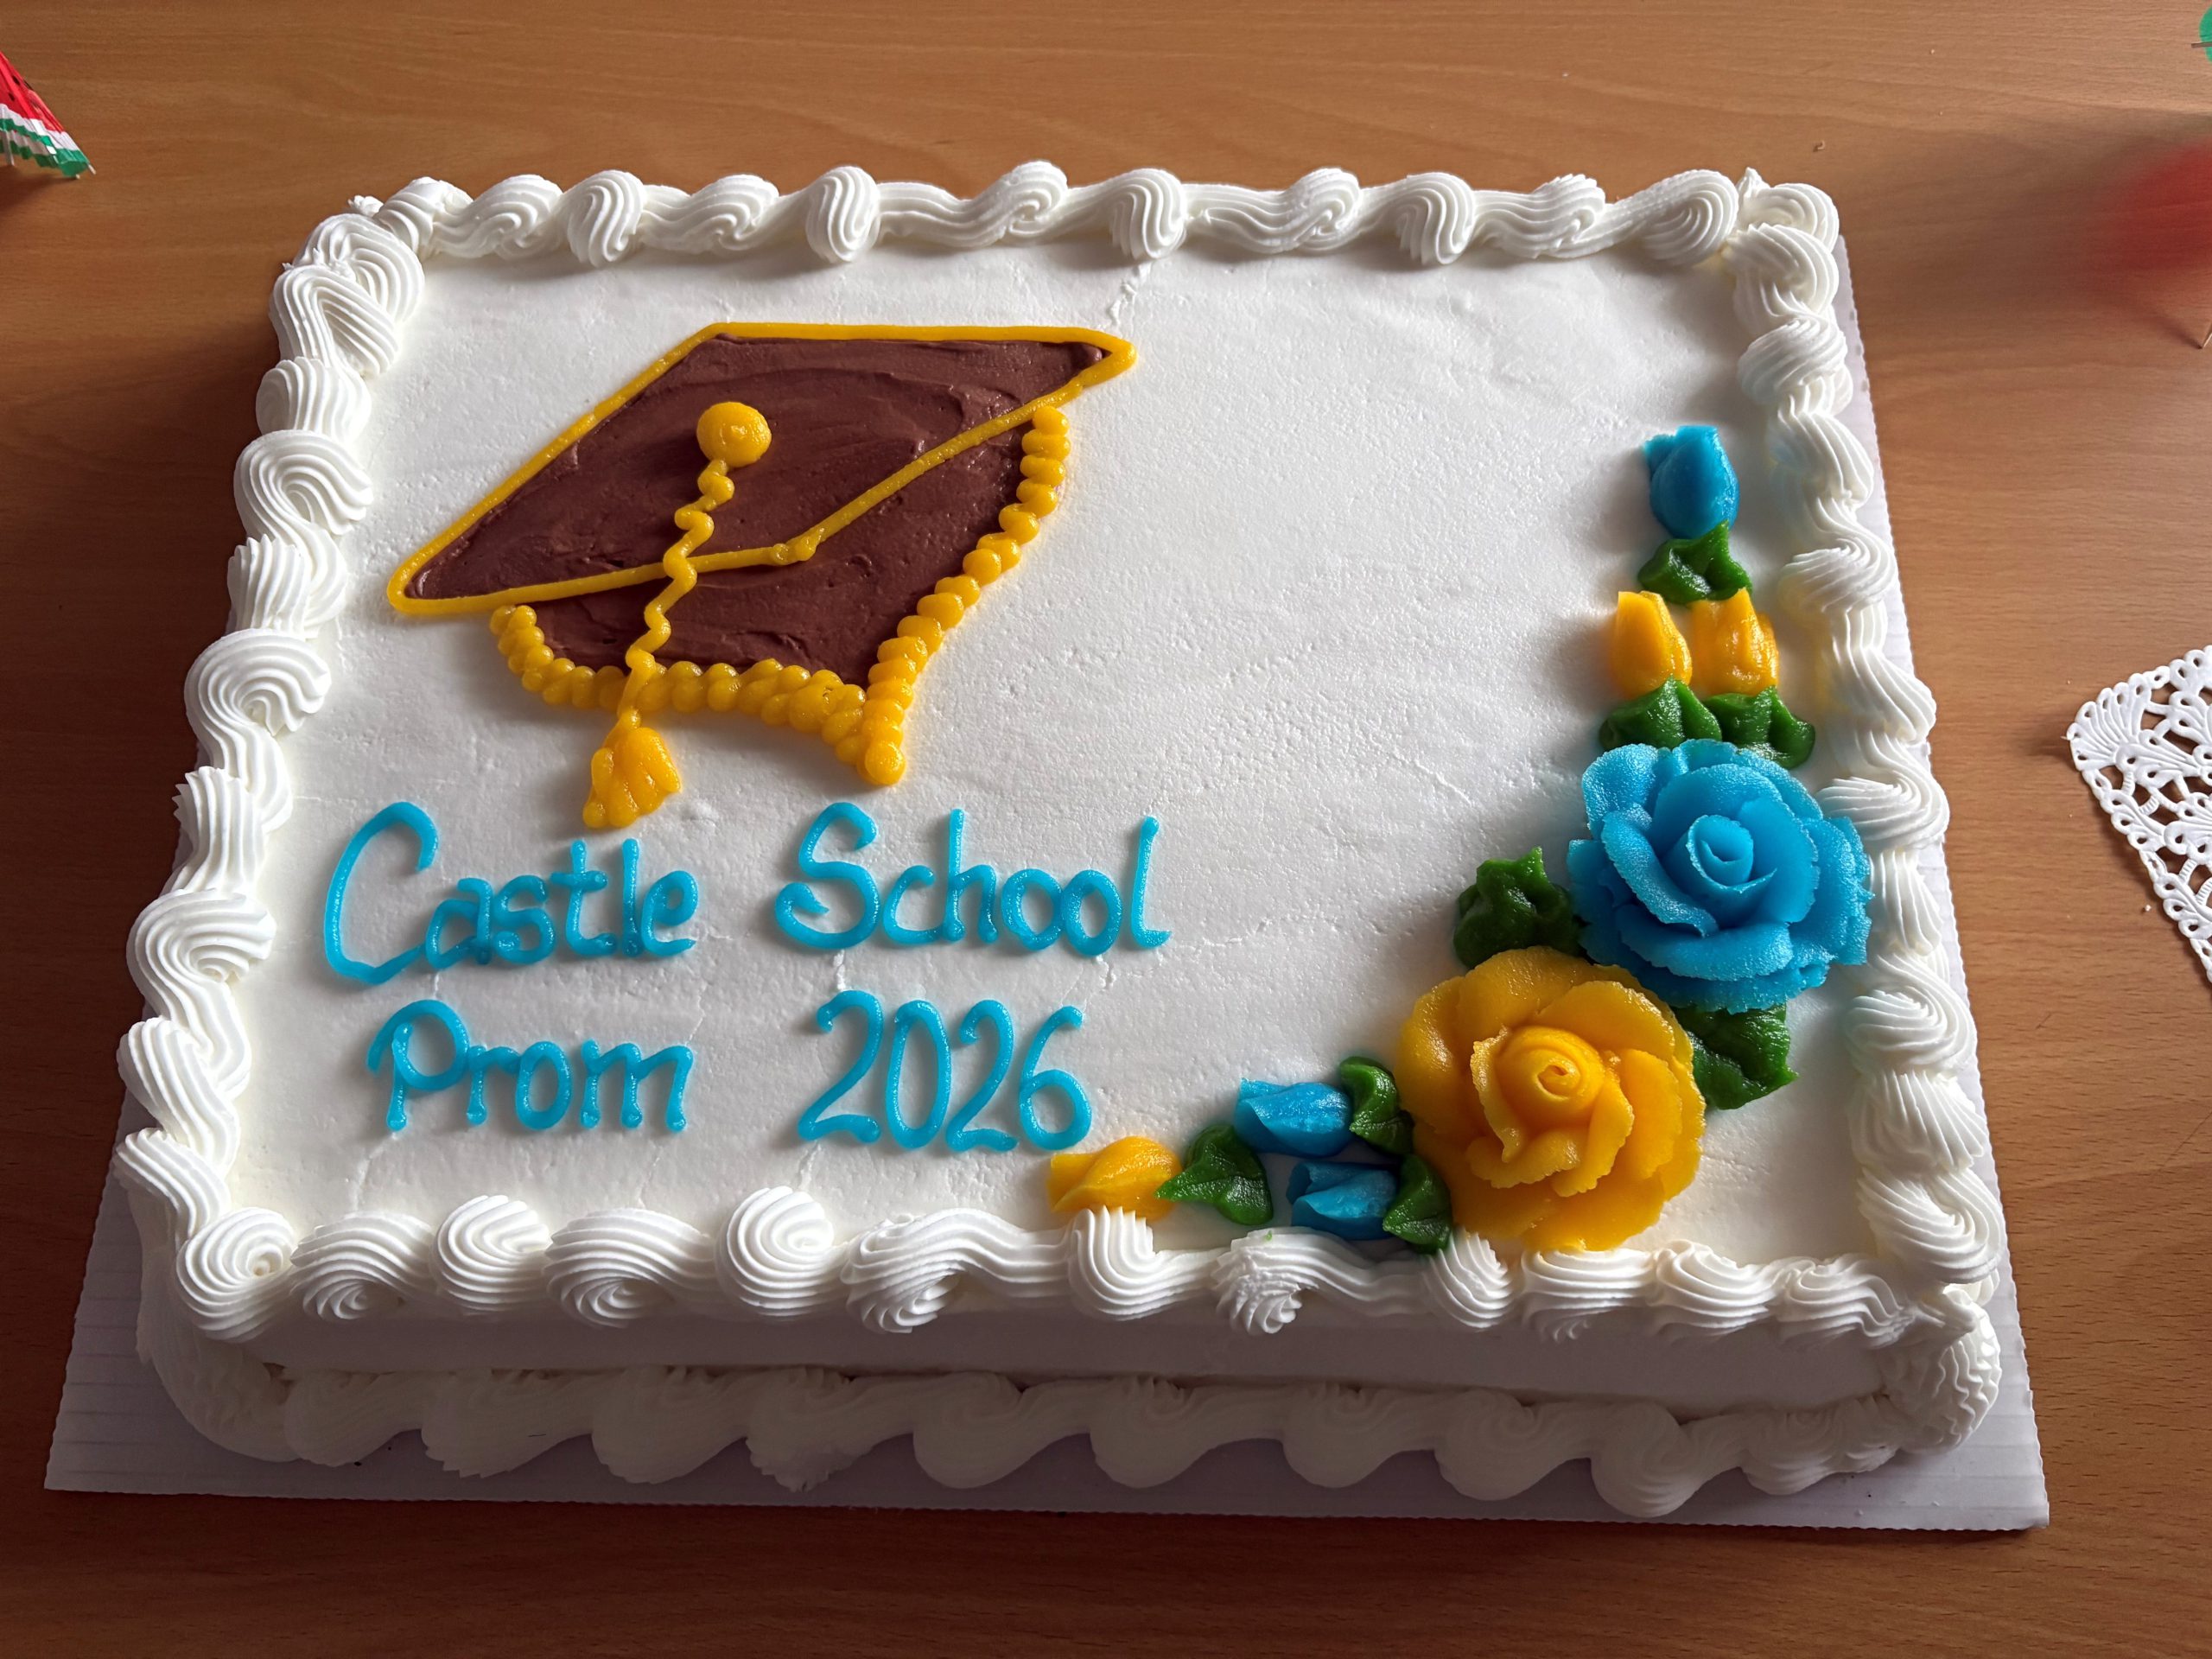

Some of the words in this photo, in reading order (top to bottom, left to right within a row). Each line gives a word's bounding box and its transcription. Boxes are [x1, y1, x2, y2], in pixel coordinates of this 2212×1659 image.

[323, 801, 699, 986] Castle
[773, 802, 1172, 957] School
[366, 999, 695, 1134] Prom
[796, 989, 1093, 1153] 2026
